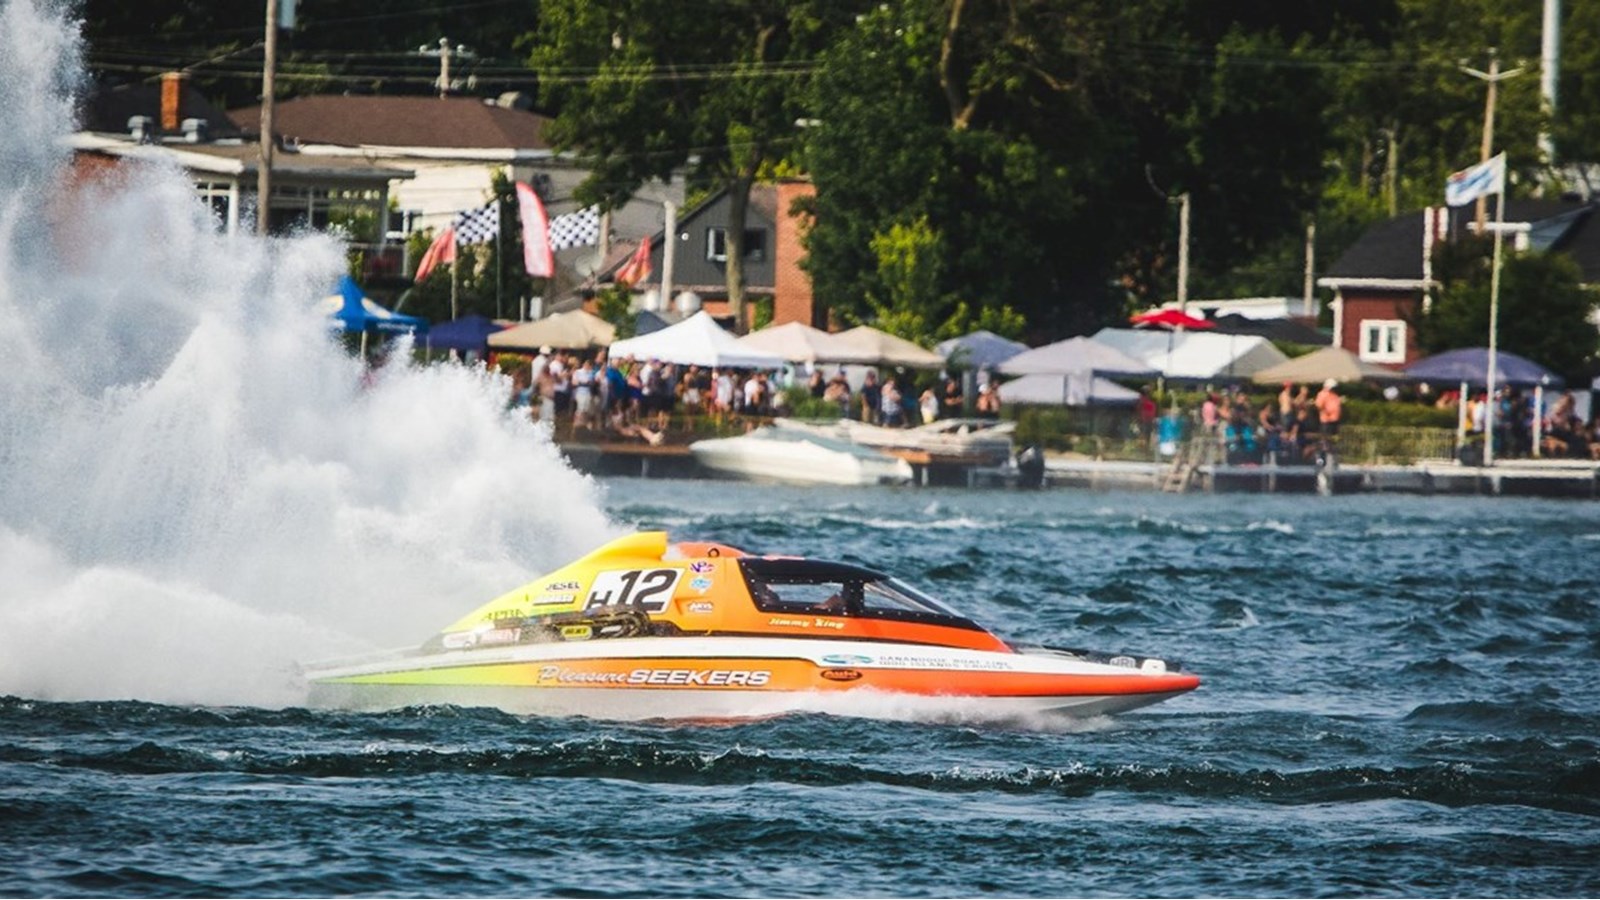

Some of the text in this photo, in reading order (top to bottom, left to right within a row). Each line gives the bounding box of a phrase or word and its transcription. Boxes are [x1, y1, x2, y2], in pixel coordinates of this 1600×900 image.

[617, 569, 677, 611] 12
[769, 617, 845, 629] Jimmy King
[537, 665, 770, 686] Pleasure SEEKERS
